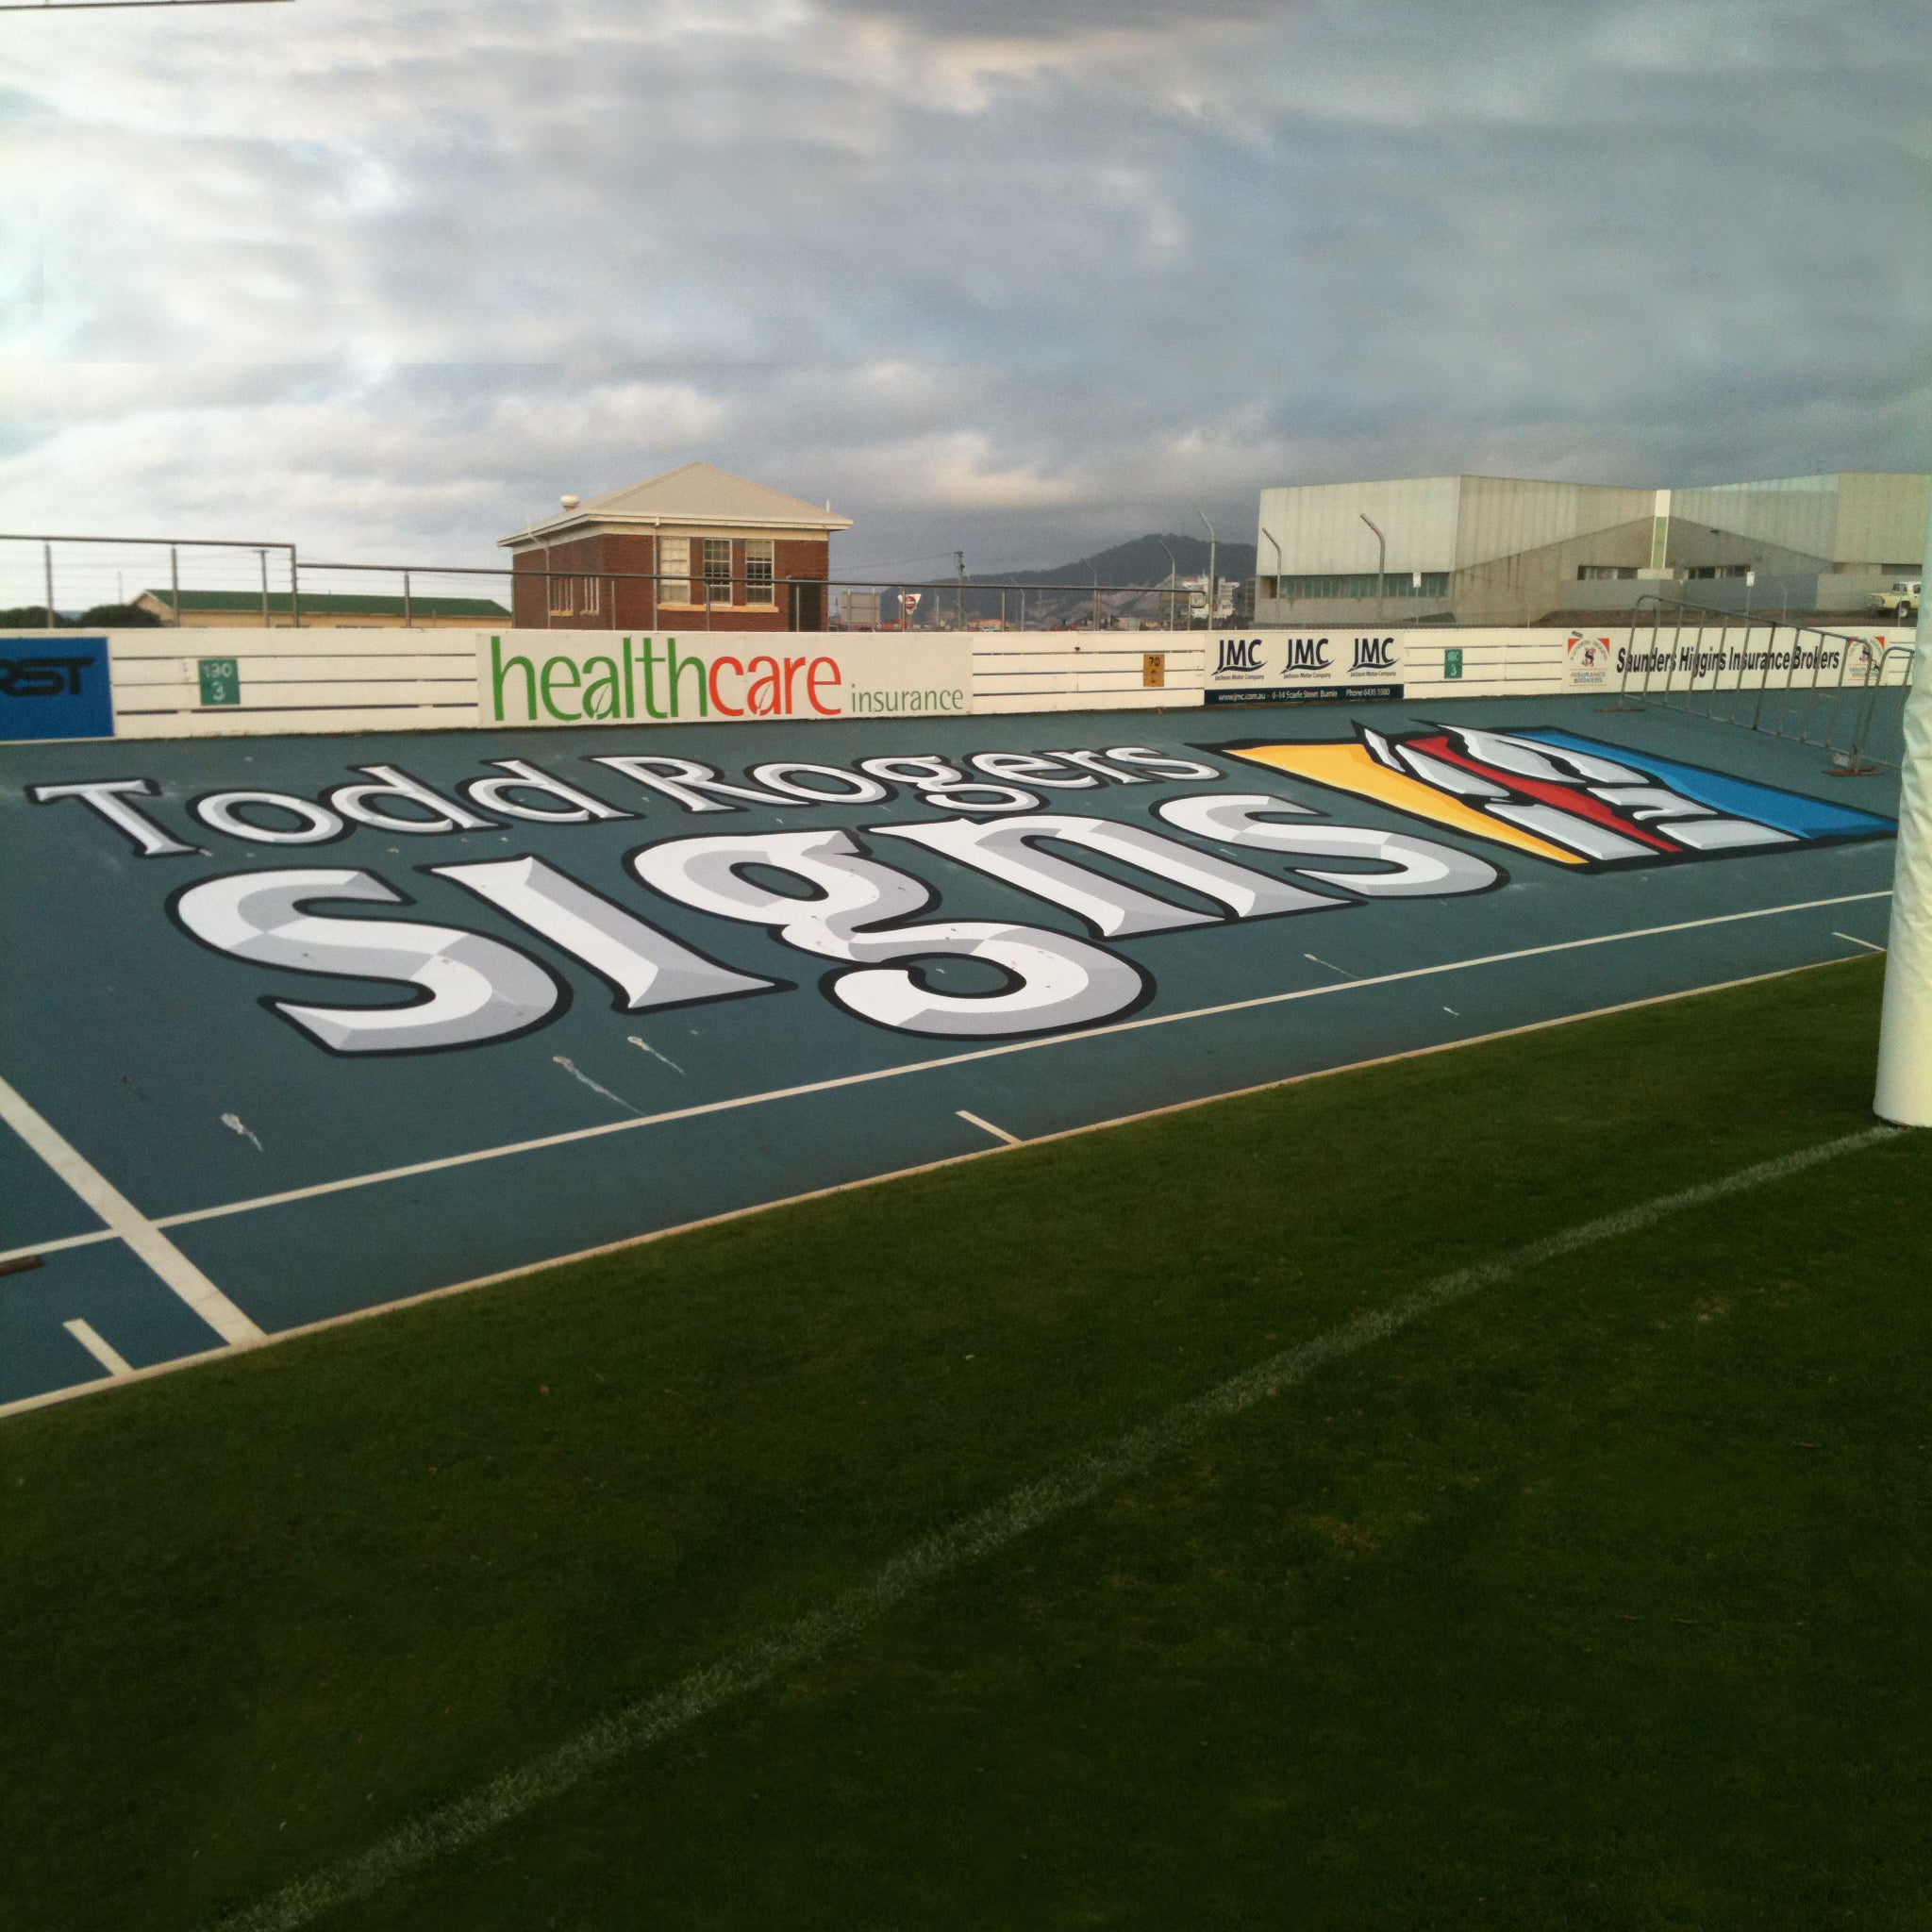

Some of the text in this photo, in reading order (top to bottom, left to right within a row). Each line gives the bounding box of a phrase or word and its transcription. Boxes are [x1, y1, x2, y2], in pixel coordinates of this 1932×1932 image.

[1214, 639, 1262, 672] JMC
[1284, 638, 1329, 671] JMC
[1350, 637, 1394, 669] JMC
[1617, 647, 1676, 673] Saunders
[1728, 646, 1790, 671] Insurance
[1791, 645, 1840, 670] Brokers
[491, 636, 964, 721] healthcare insurance
[31, 745, 1222, 856] Todd Rogers
